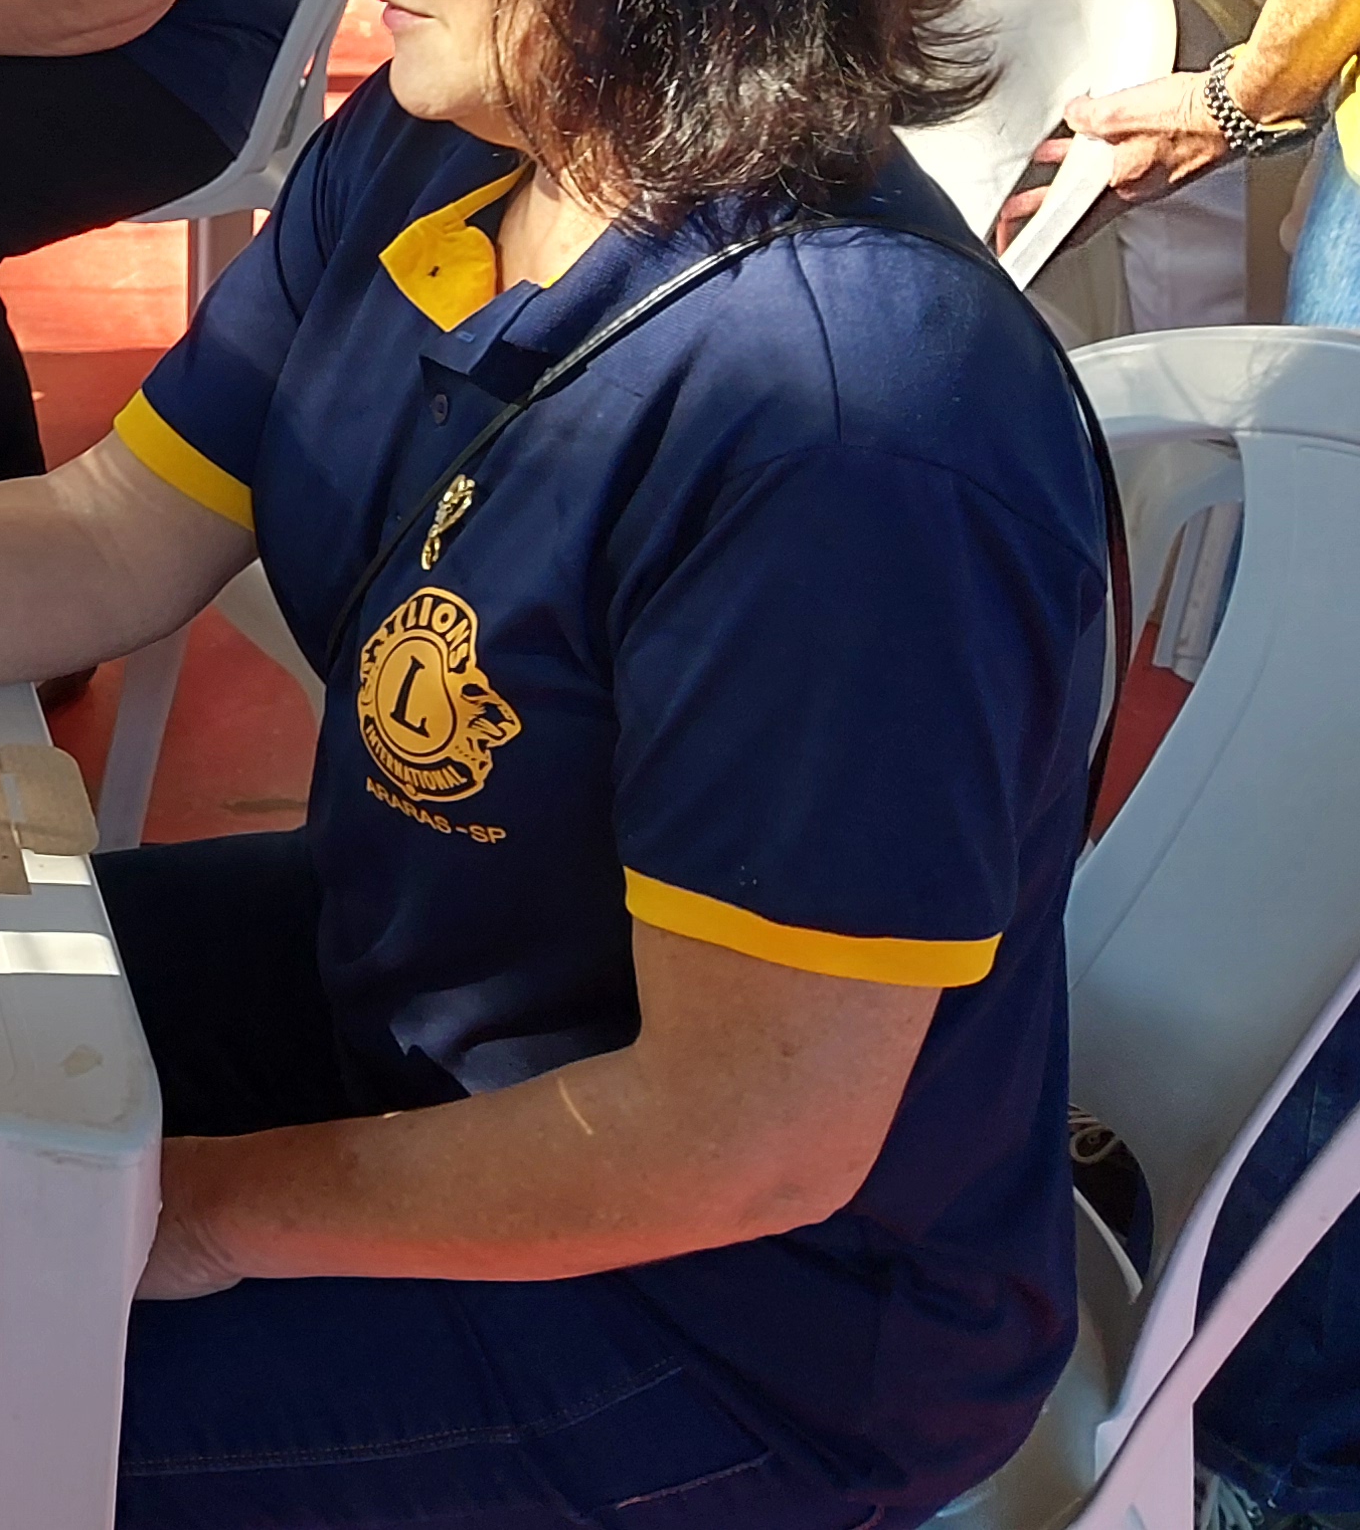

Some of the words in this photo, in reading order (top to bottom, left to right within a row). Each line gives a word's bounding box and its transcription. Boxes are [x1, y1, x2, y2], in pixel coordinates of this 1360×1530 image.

[404, 596, 470, 670] LIONS
[390, 655, 430, 738] L
[365, 723, 468, 791] INTERNATIONAL
